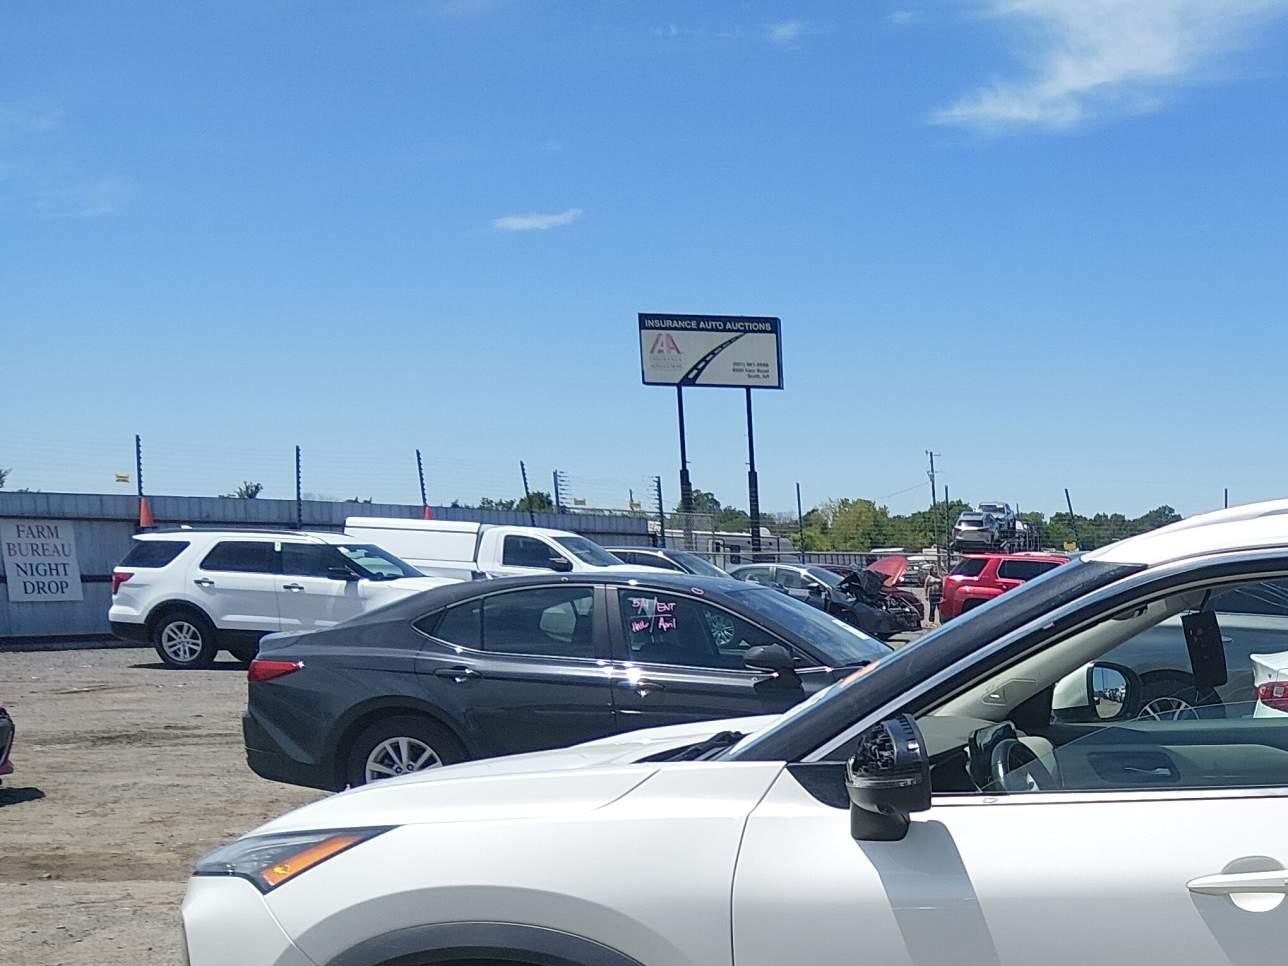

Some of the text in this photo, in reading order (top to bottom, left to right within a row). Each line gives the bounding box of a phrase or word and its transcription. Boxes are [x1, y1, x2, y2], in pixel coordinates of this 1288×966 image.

[645, 319, 772, 331] INSURANCE AUTO AUCTIONS
[16, 524, 59, 539] FARM
[6, 542, 71, 557] BUREAU
[15, 562, 70, 577] NIGHT
[22, 580, 69, 595] DROP
